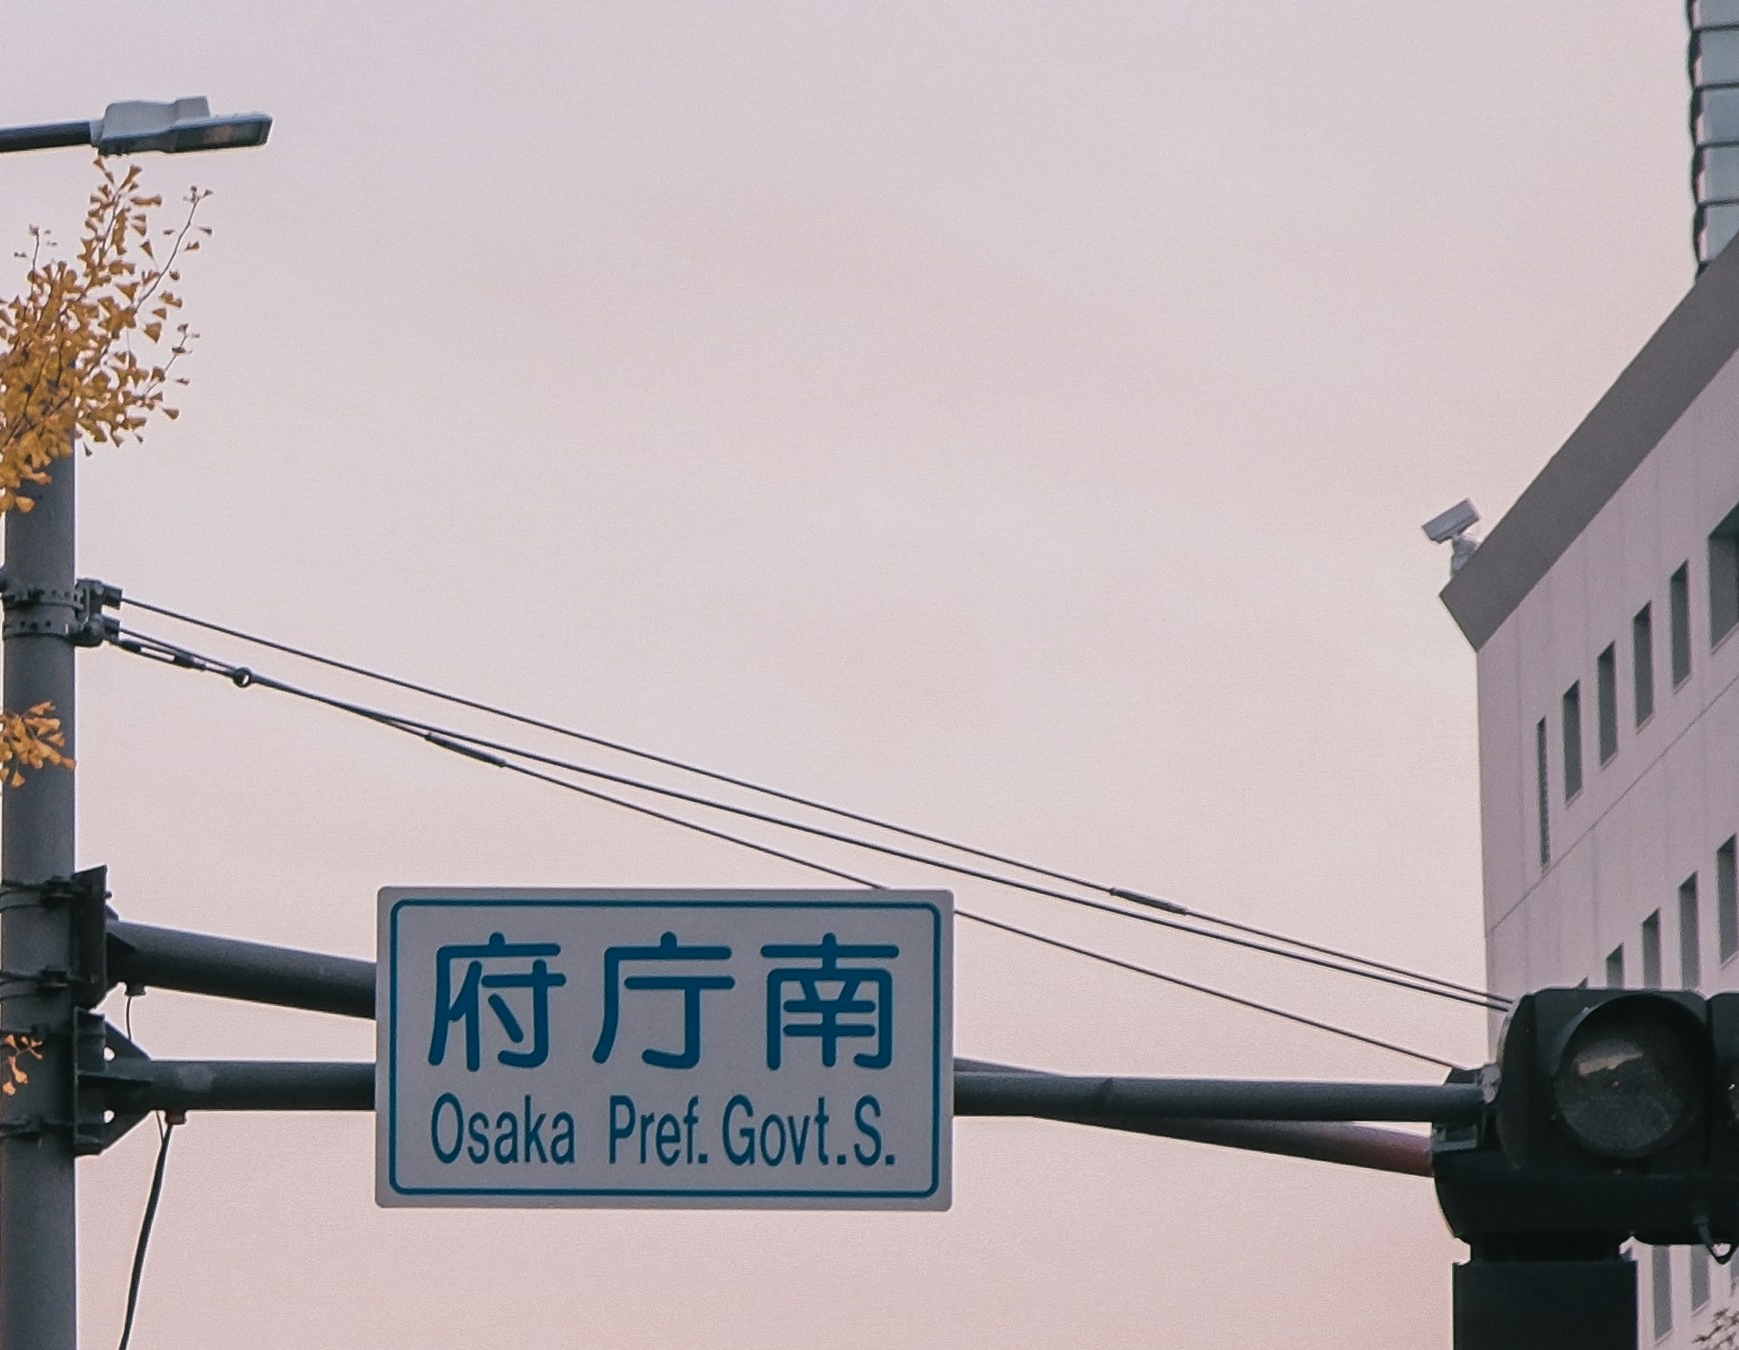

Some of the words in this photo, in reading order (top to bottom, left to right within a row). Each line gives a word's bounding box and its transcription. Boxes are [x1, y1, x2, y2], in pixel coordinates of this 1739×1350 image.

[427, 931, 900, 1071] 府庁南
[431, 1092, 576, 1165] Osaka
[608, 1094, 709, 1165] Pref.
